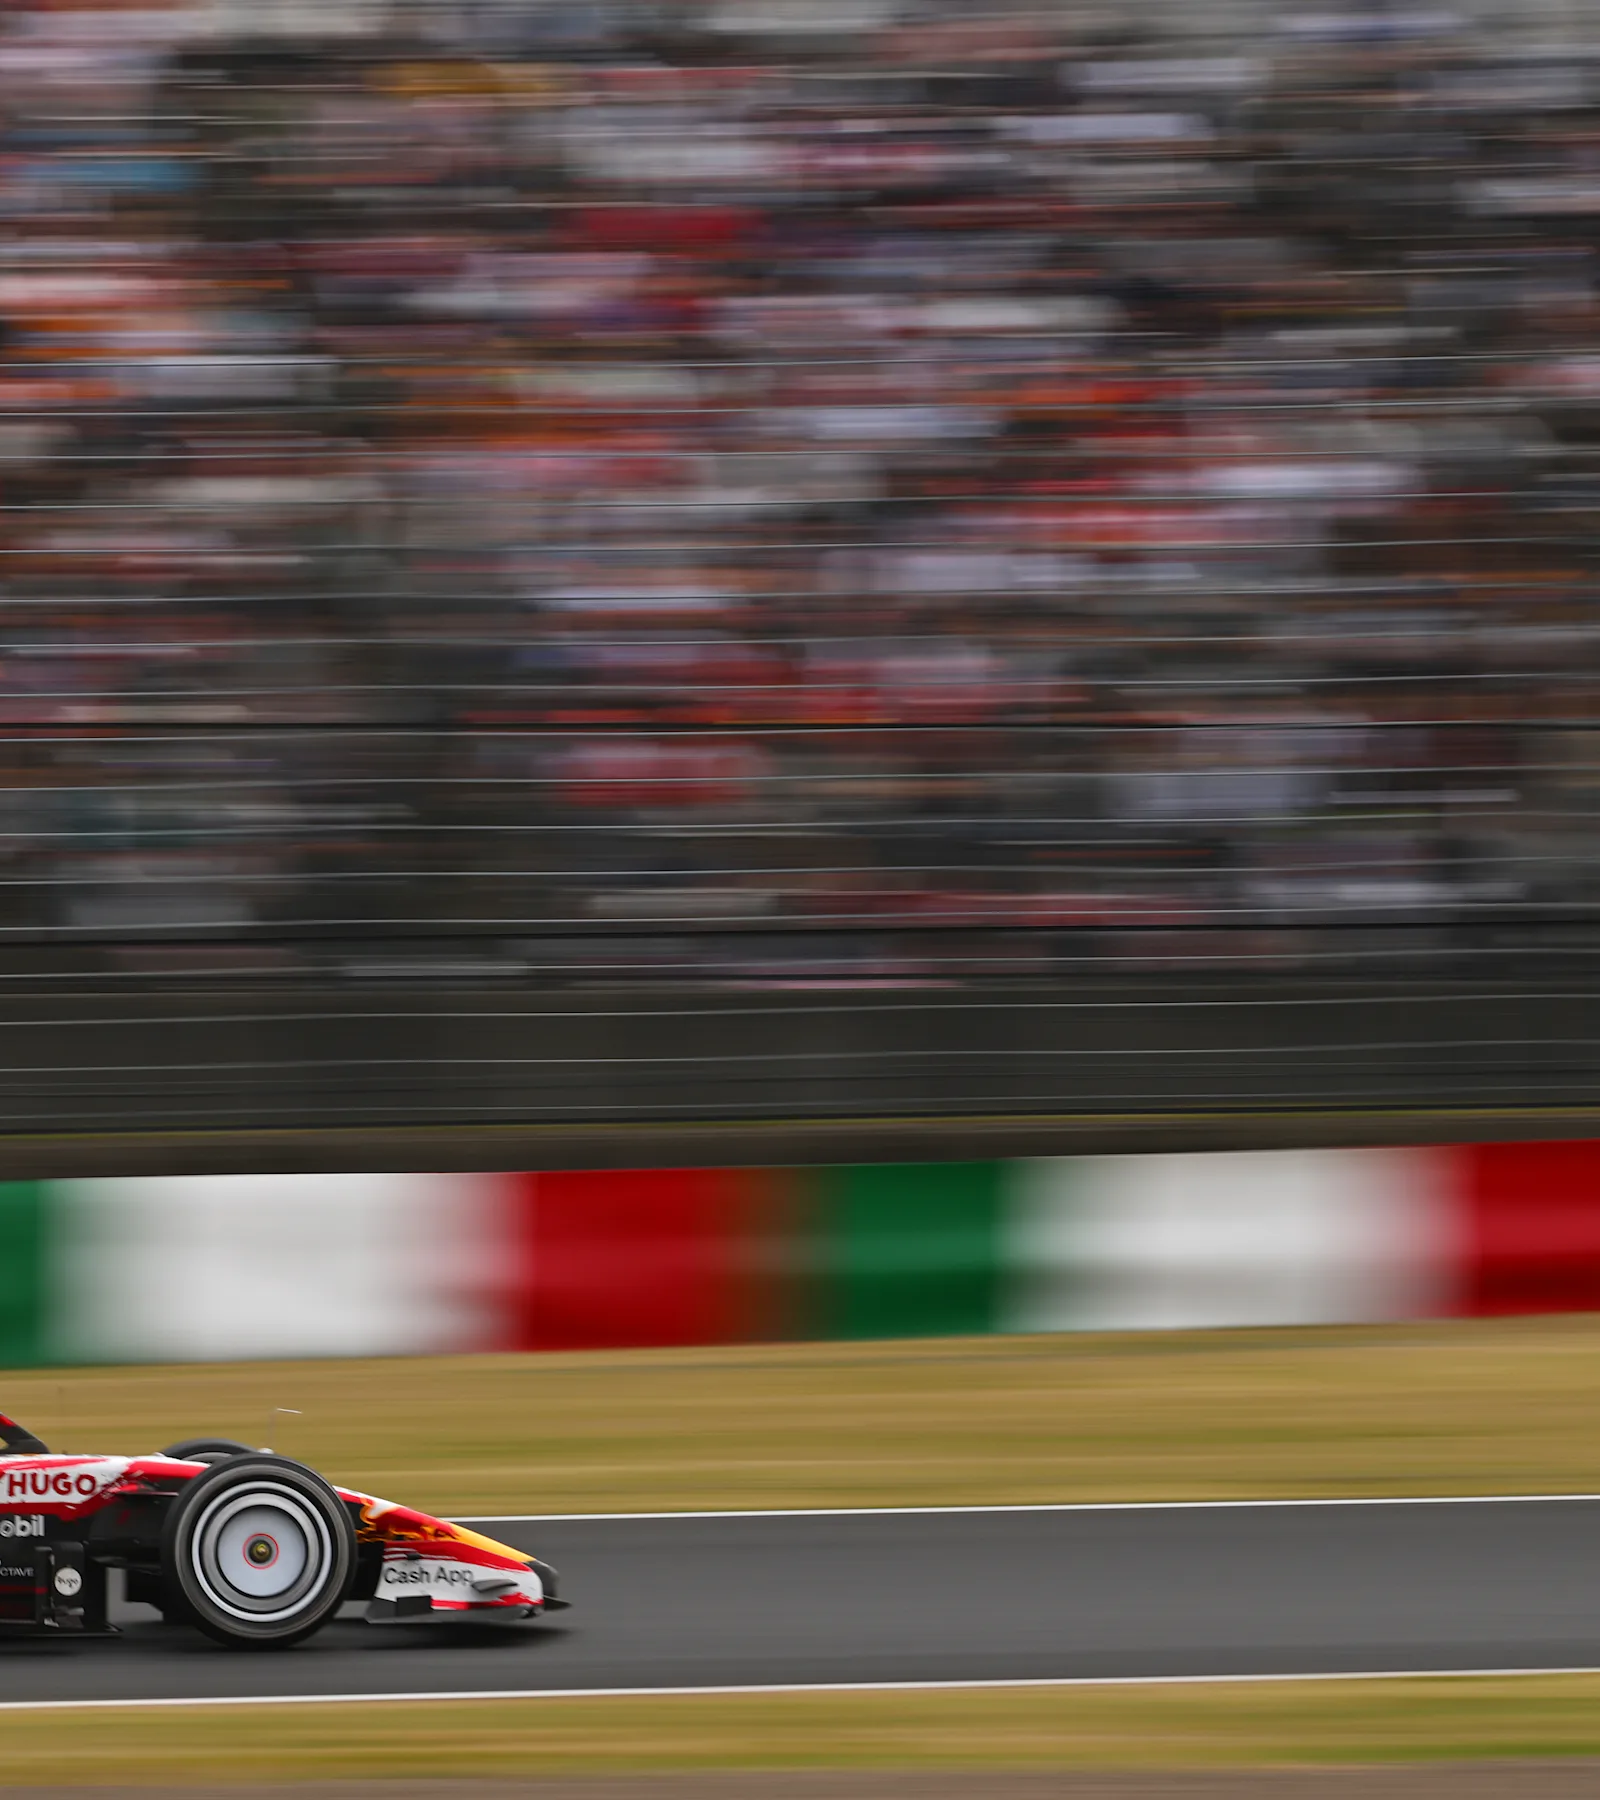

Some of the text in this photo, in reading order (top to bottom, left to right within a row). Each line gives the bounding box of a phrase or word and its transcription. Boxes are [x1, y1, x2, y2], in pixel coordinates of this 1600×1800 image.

[8, 1471, 97, 1497] HUGO
[384, 1566, 474, 1586] Cash App
